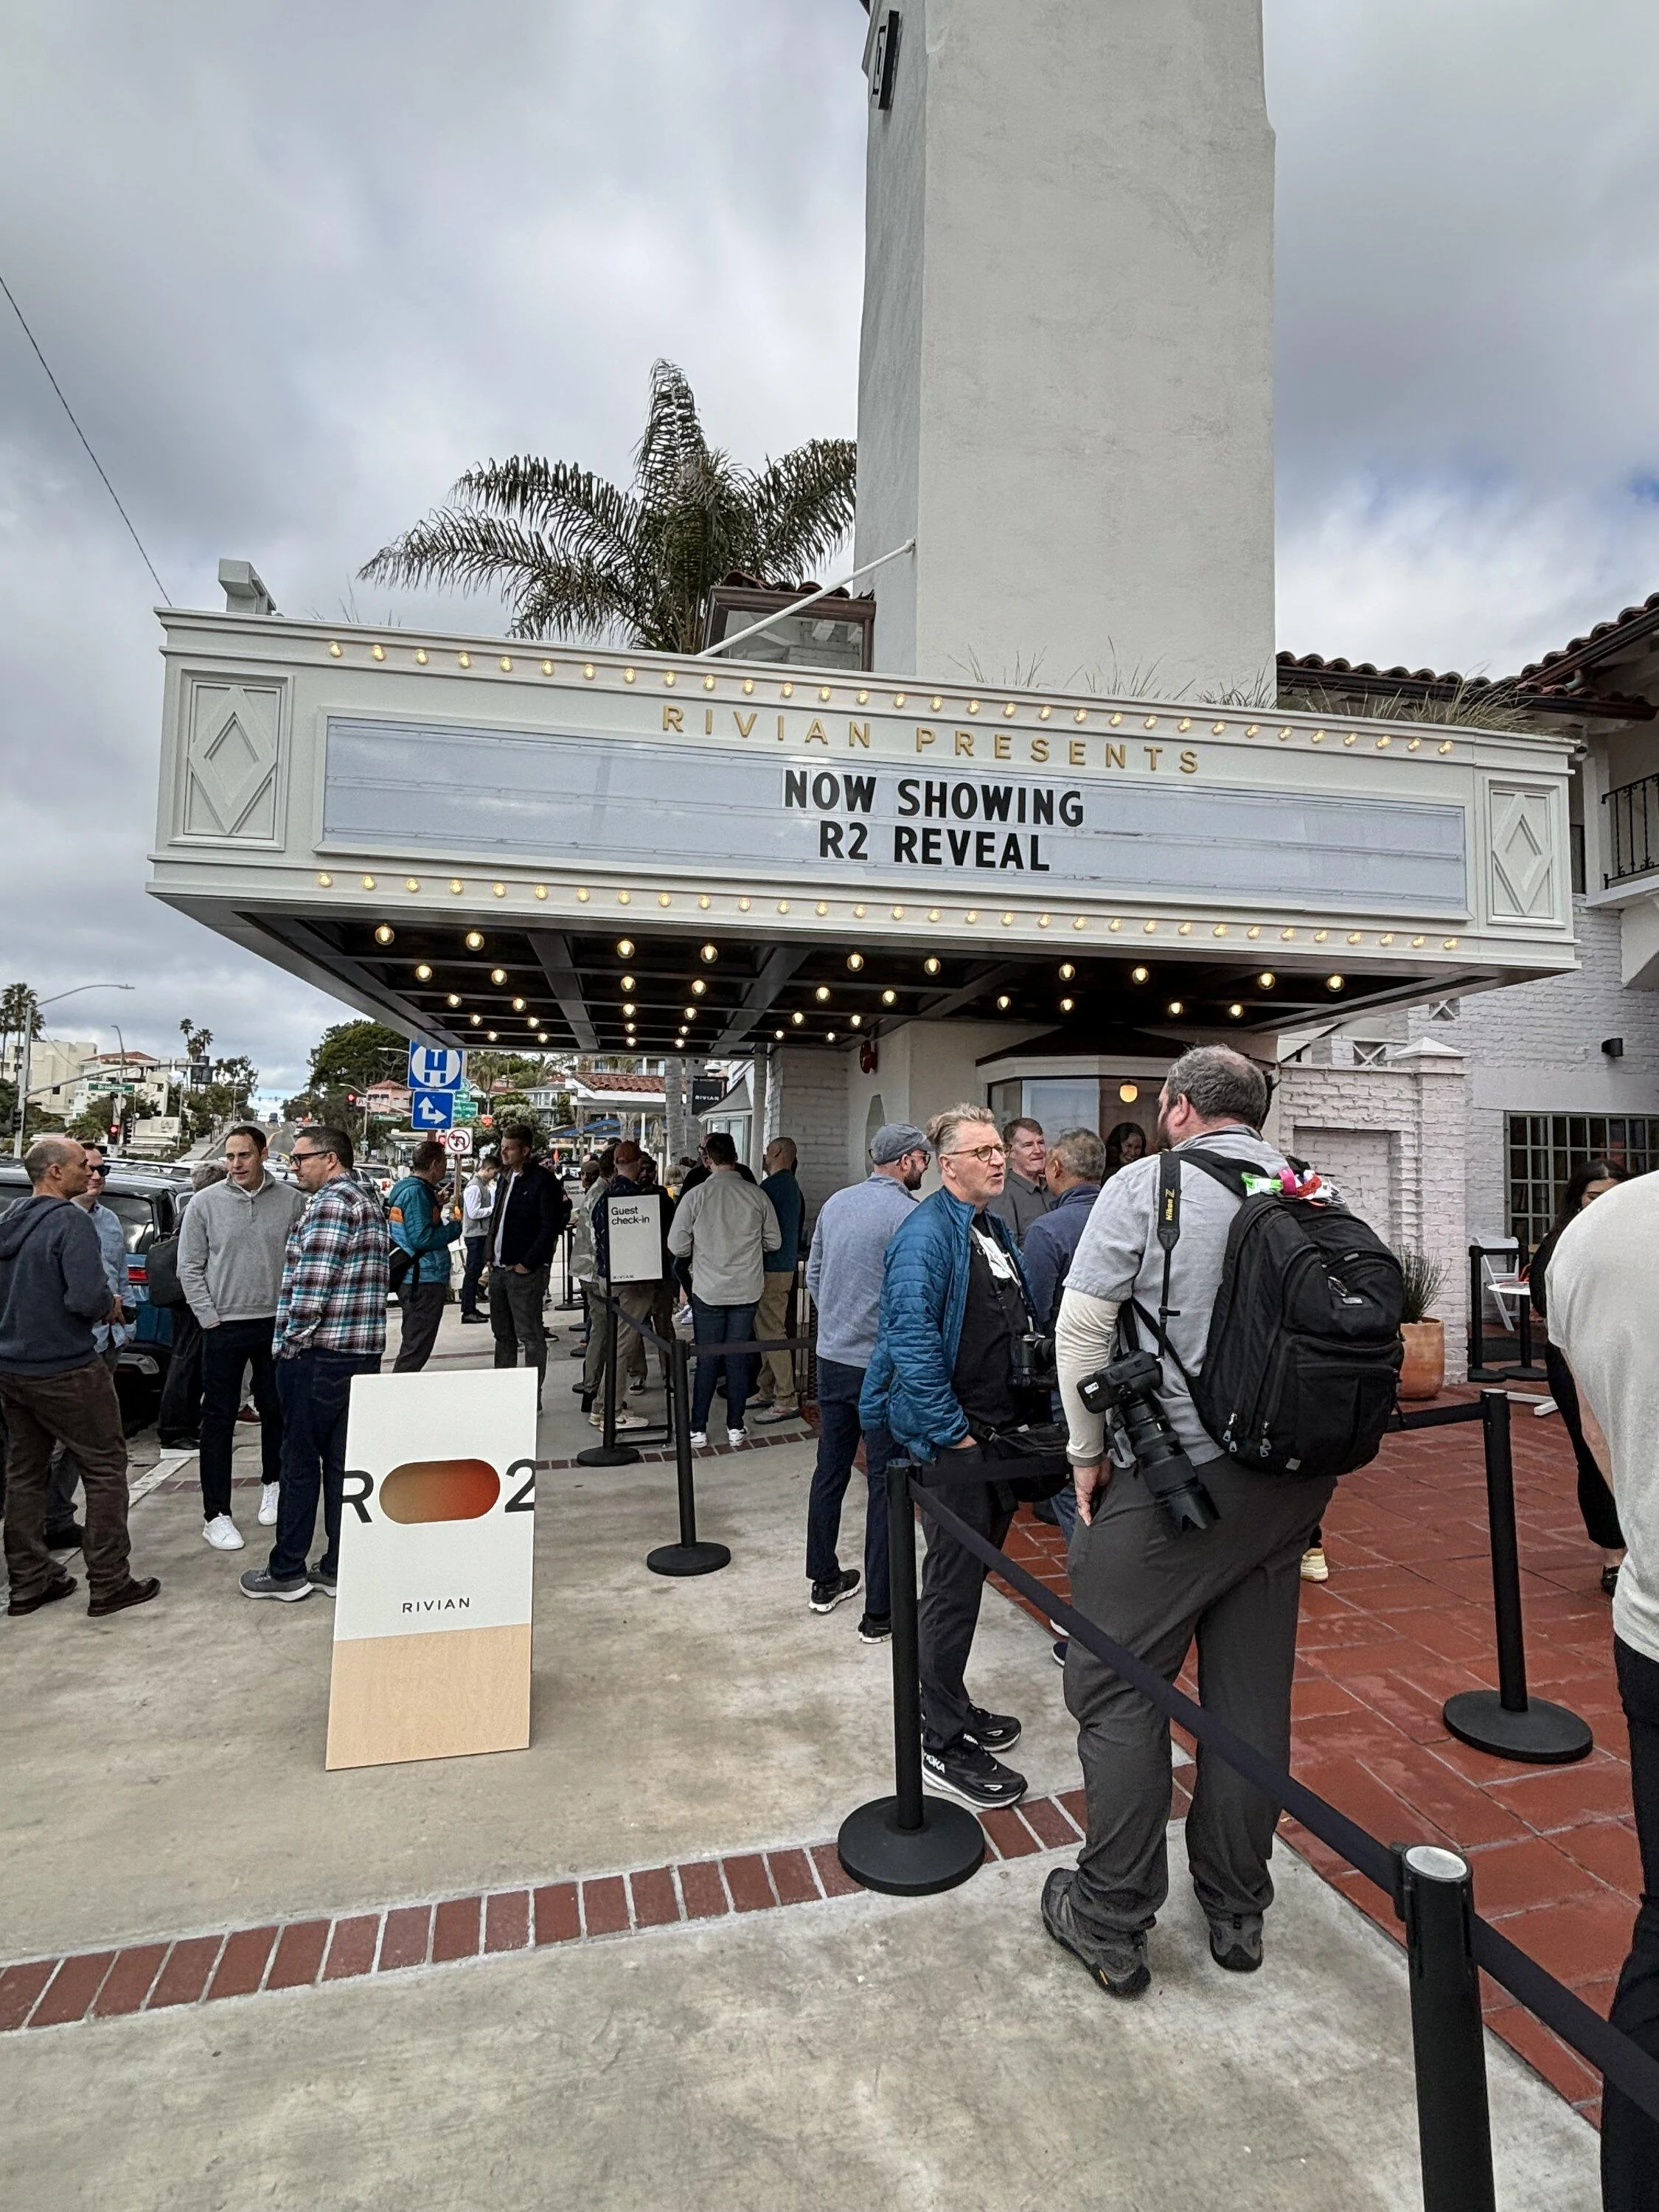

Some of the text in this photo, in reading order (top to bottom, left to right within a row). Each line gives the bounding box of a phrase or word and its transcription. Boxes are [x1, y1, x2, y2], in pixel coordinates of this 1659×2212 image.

[661, 704, 1200, 773] RIVIAN PRESENTS
[784, 771, 1085, 828] NOW SHOWING
[819, 821, 1051, 872] R2 REVEAL
[611, 1206, 639, 1216] Guest
[611, 1215, 650, 1225] check-in
[1165, 1199, 1173, 1221] Nikon
[504, 1458, 536, 1513] 2
[402, 1597, 471, 1614] RIVIAN
[963, 1733, 978, 1745] HOKA
